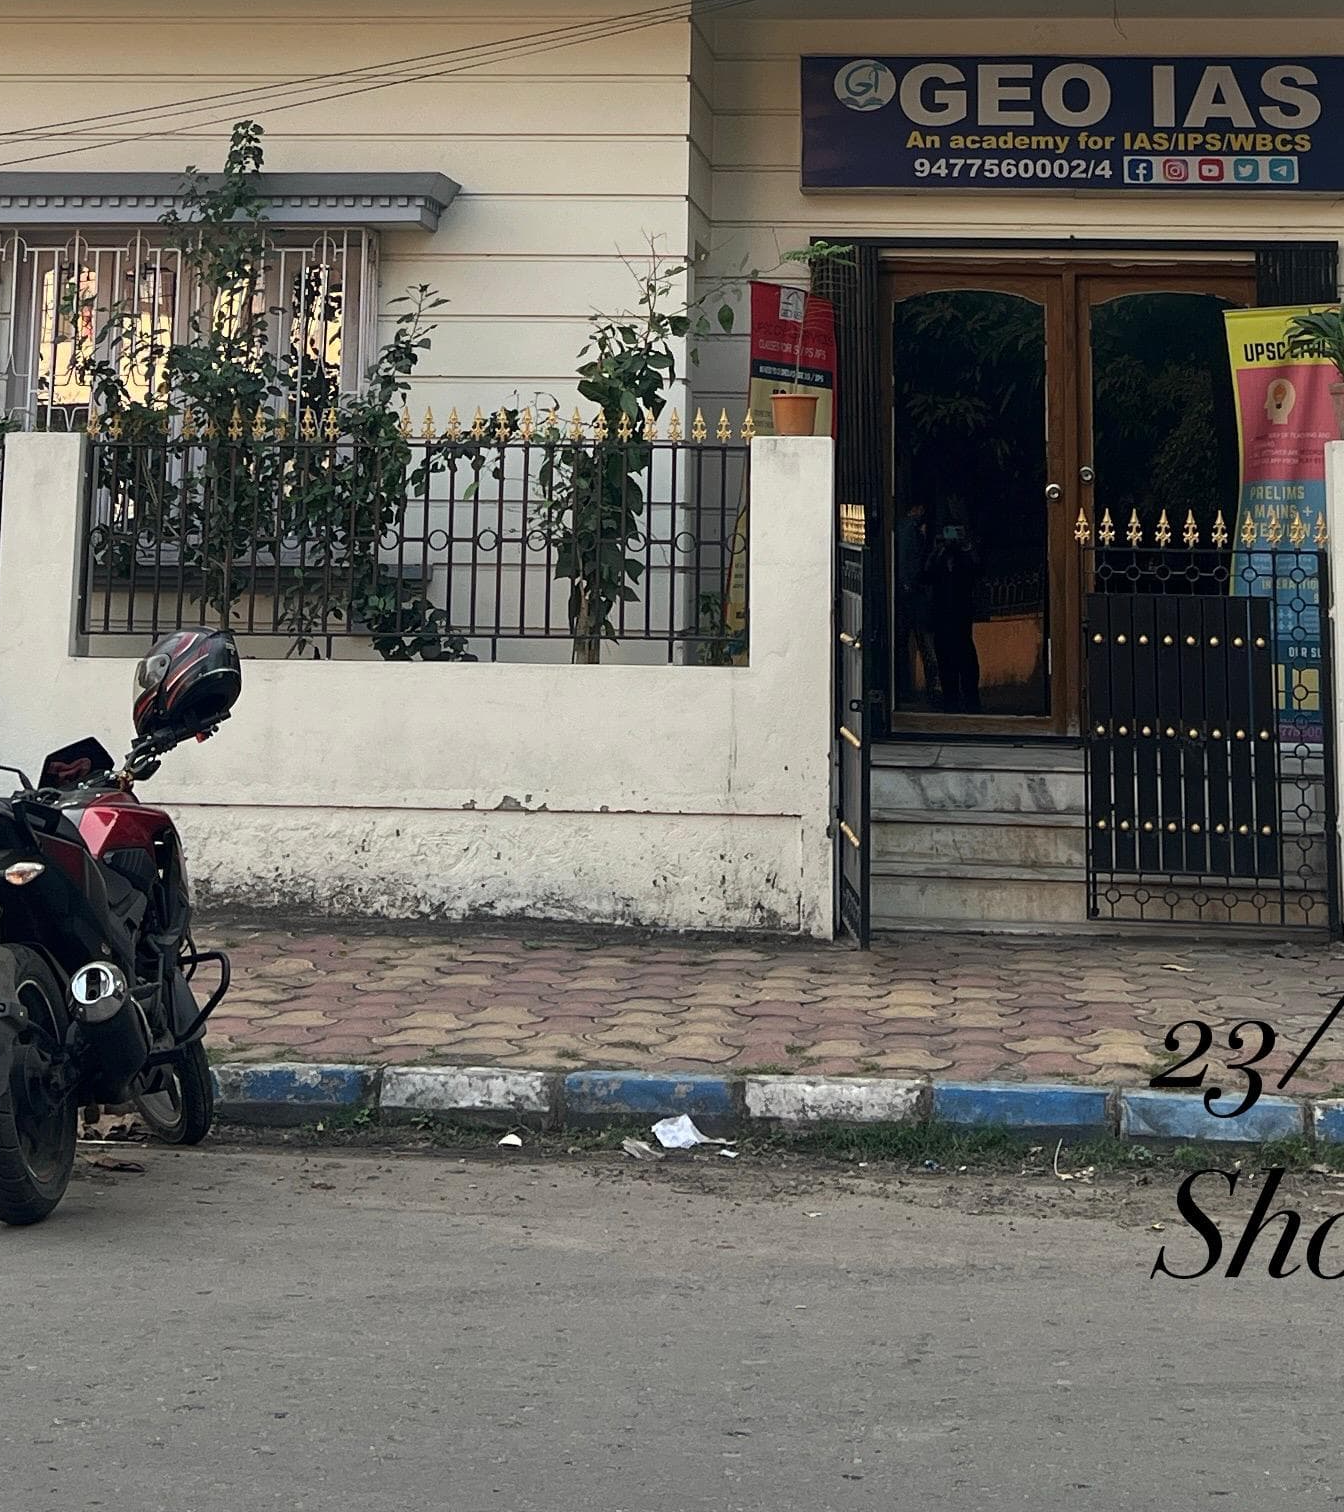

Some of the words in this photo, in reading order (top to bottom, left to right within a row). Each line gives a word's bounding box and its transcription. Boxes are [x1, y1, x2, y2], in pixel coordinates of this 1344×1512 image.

[898, 63, 1113, 129] GEO
[1151, 63, 1323, 130] IAS
[905, 130, 941, 152] An
[949, 130, 1070, 156] academy
[1077, 130, 1116, 152] for
[1123, 131, 1313, 153] IAS/IPS/WBCS
[913, 157, 1114, 180] 9477560002/4
[1243, 341, 1287, 363] UPSC
[1250, 485, 1305, 502] PRELIMS
[1254, 504, 1298, 520] MAINS
